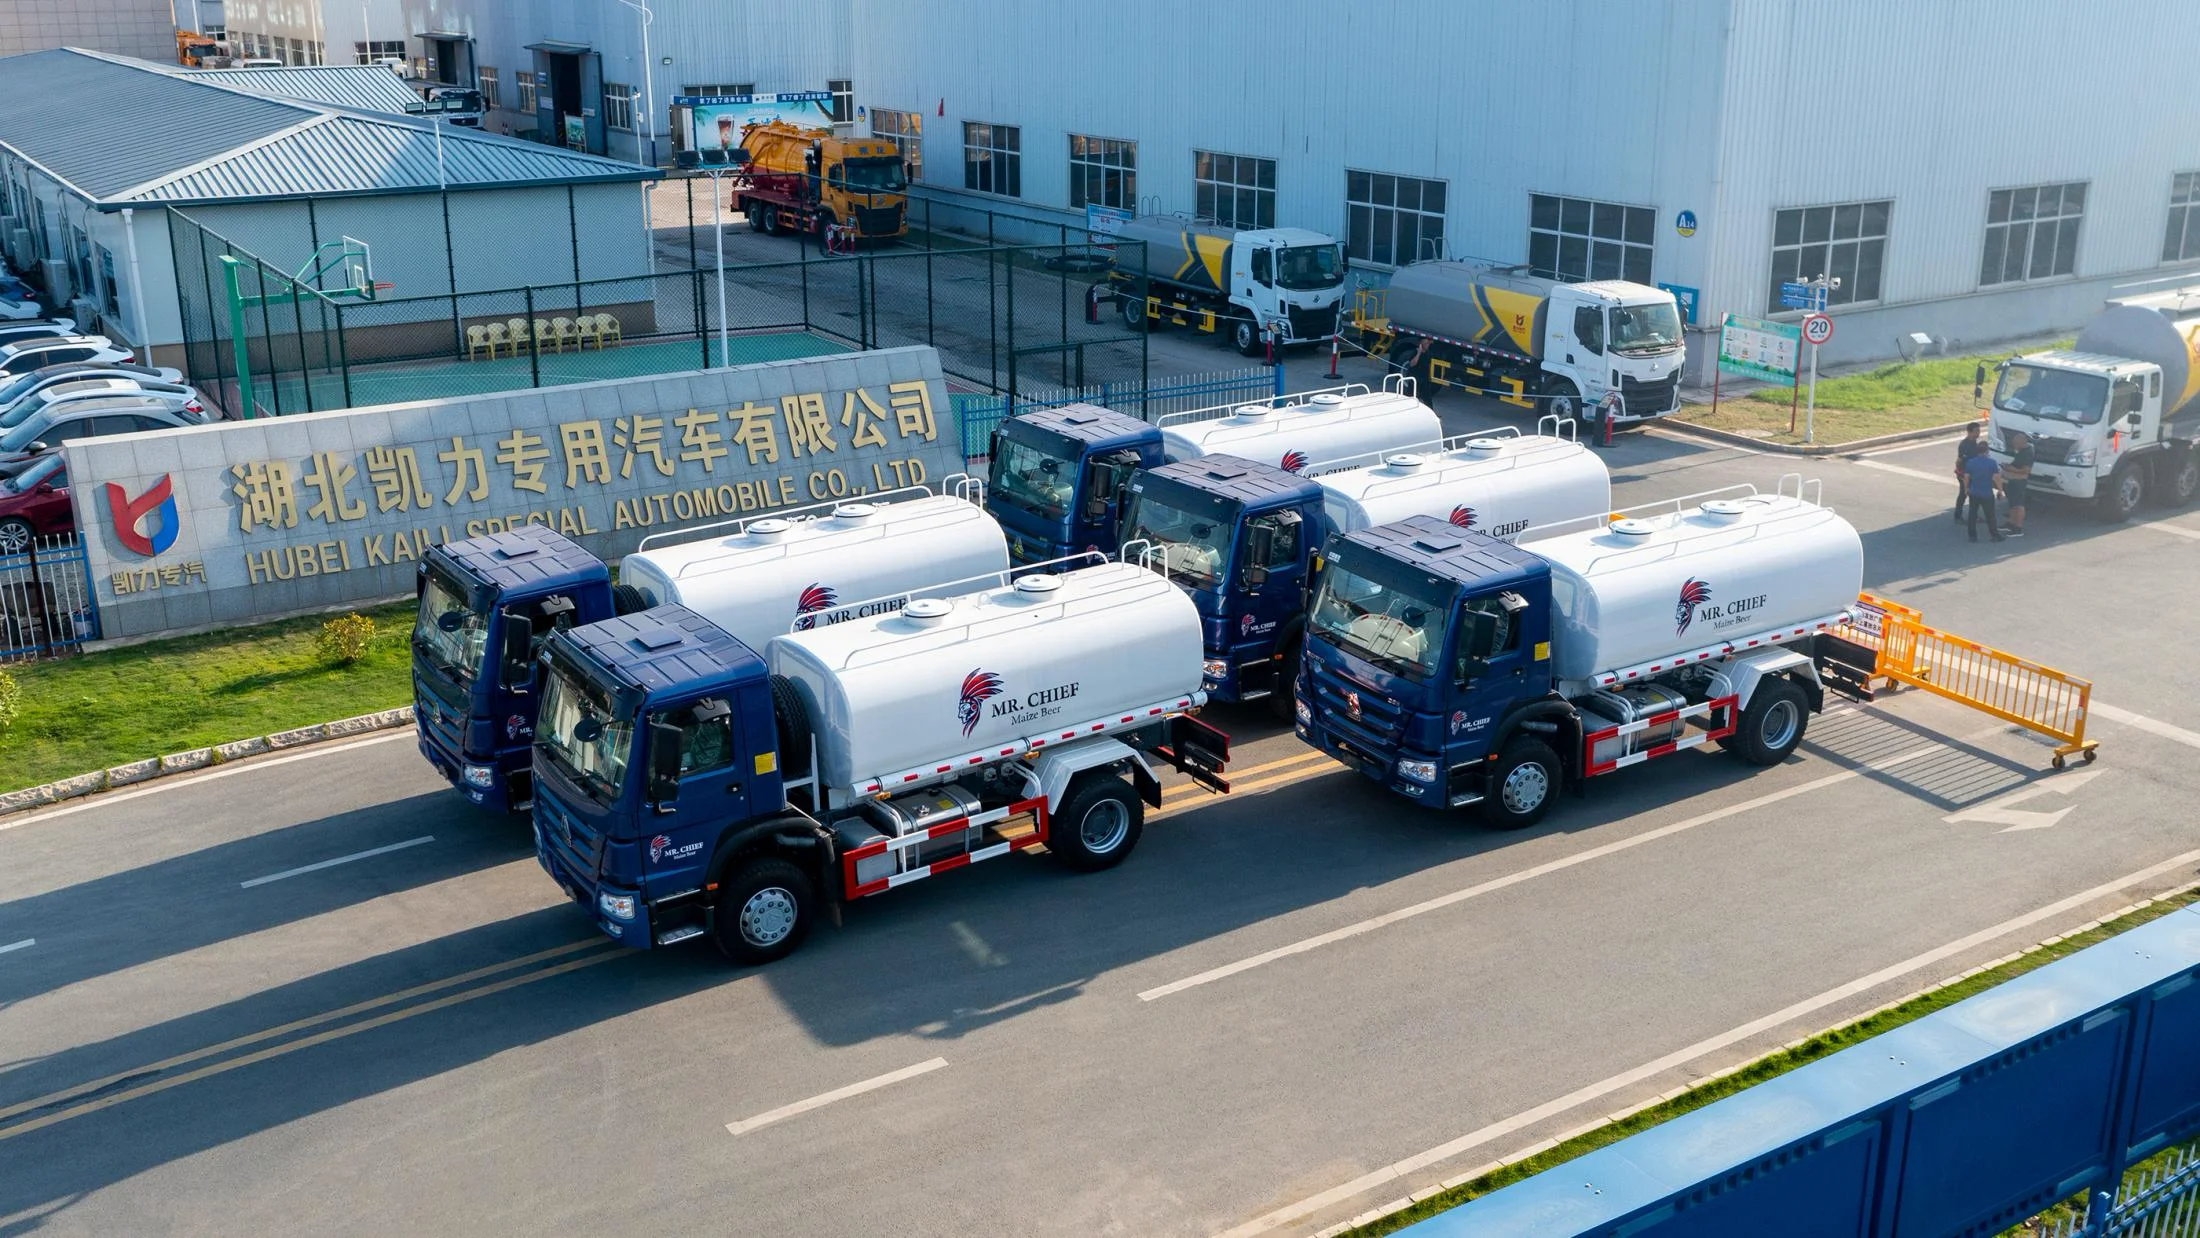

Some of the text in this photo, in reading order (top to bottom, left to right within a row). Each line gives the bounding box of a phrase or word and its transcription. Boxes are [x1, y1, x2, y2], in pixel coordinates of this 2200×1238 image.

[1810, 321, 1828, 334] 20
[231, 380, 938, 534] 湖北凯力专用汽车有限公司
[246, 539, 351, 585] HUBEI
[615, 475, 798, 530] AUTOMOBILE
[1492, 519, 1529, 537] CHIEF
[111, 561, 207, 595] 凯力专汽
[827, 598, 907, 626] MR. CHIEF
[1700, 594, 1767, 622] MR. CHIEF
[1713, 614, 1752, 631] Maize Beer
[992, 682, 1080, 718] MR. CHIEF
[1011, 705, 1062, 725] Maize Beer
[1473, 717, 1491, 726] CHIEF
[665, 841, 704, 857] MR. CHIEF
